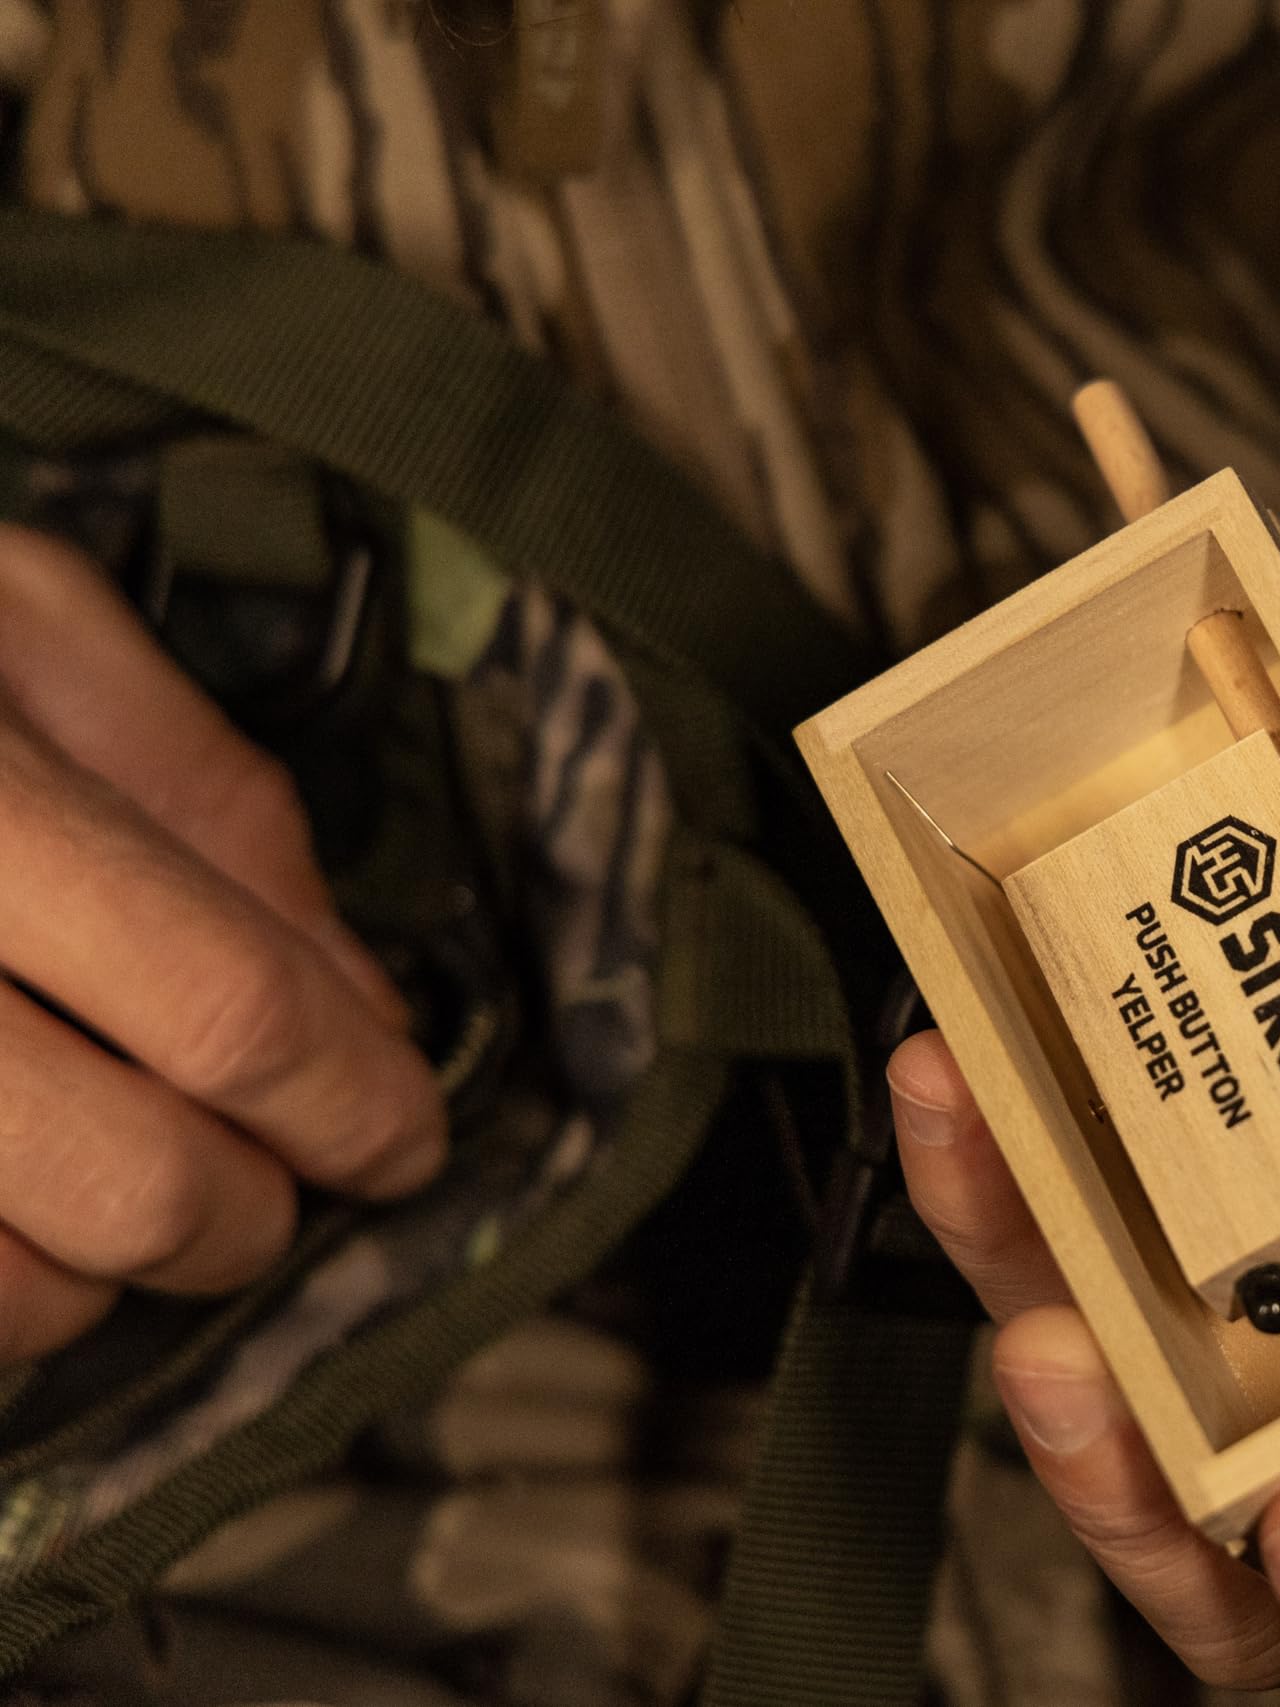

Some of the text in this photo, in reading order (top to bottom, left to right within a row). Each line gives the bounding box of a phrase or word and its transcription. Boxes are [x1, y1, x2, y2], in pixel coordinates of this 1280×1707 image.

[1111, 972, 1186, 1102] YELPER
[1125, 901, 1253, 1130] PUSH BUTTON
